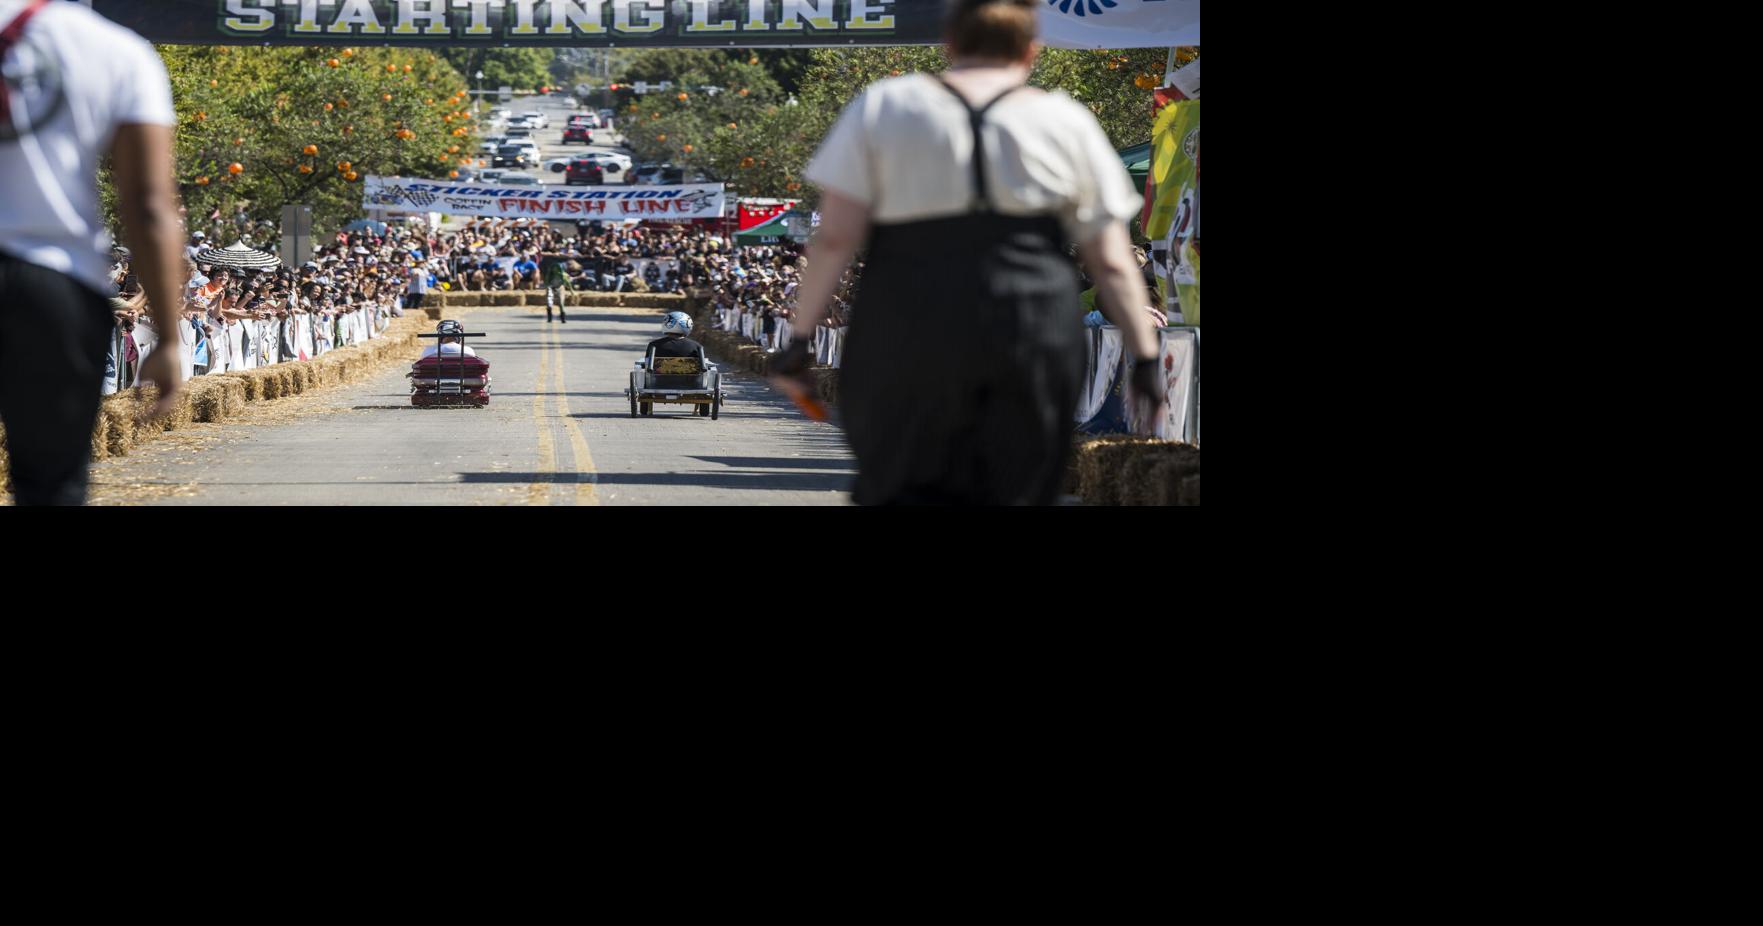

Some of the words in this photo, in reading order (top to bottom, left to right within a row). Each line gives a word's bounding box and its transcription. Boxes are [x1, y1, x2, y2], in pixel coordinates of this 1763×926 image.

[224, 0, 665, 34] STARTING
[685, 0, 896, 32] LINE
[405, 183, 545, 198] STICKER
[547, 189, 683, 200] STATION
[443, 196, 492, 205] COFFIN
[495, 198, 606, 214] FINISH
[618, 198, 691, 214] LINE
